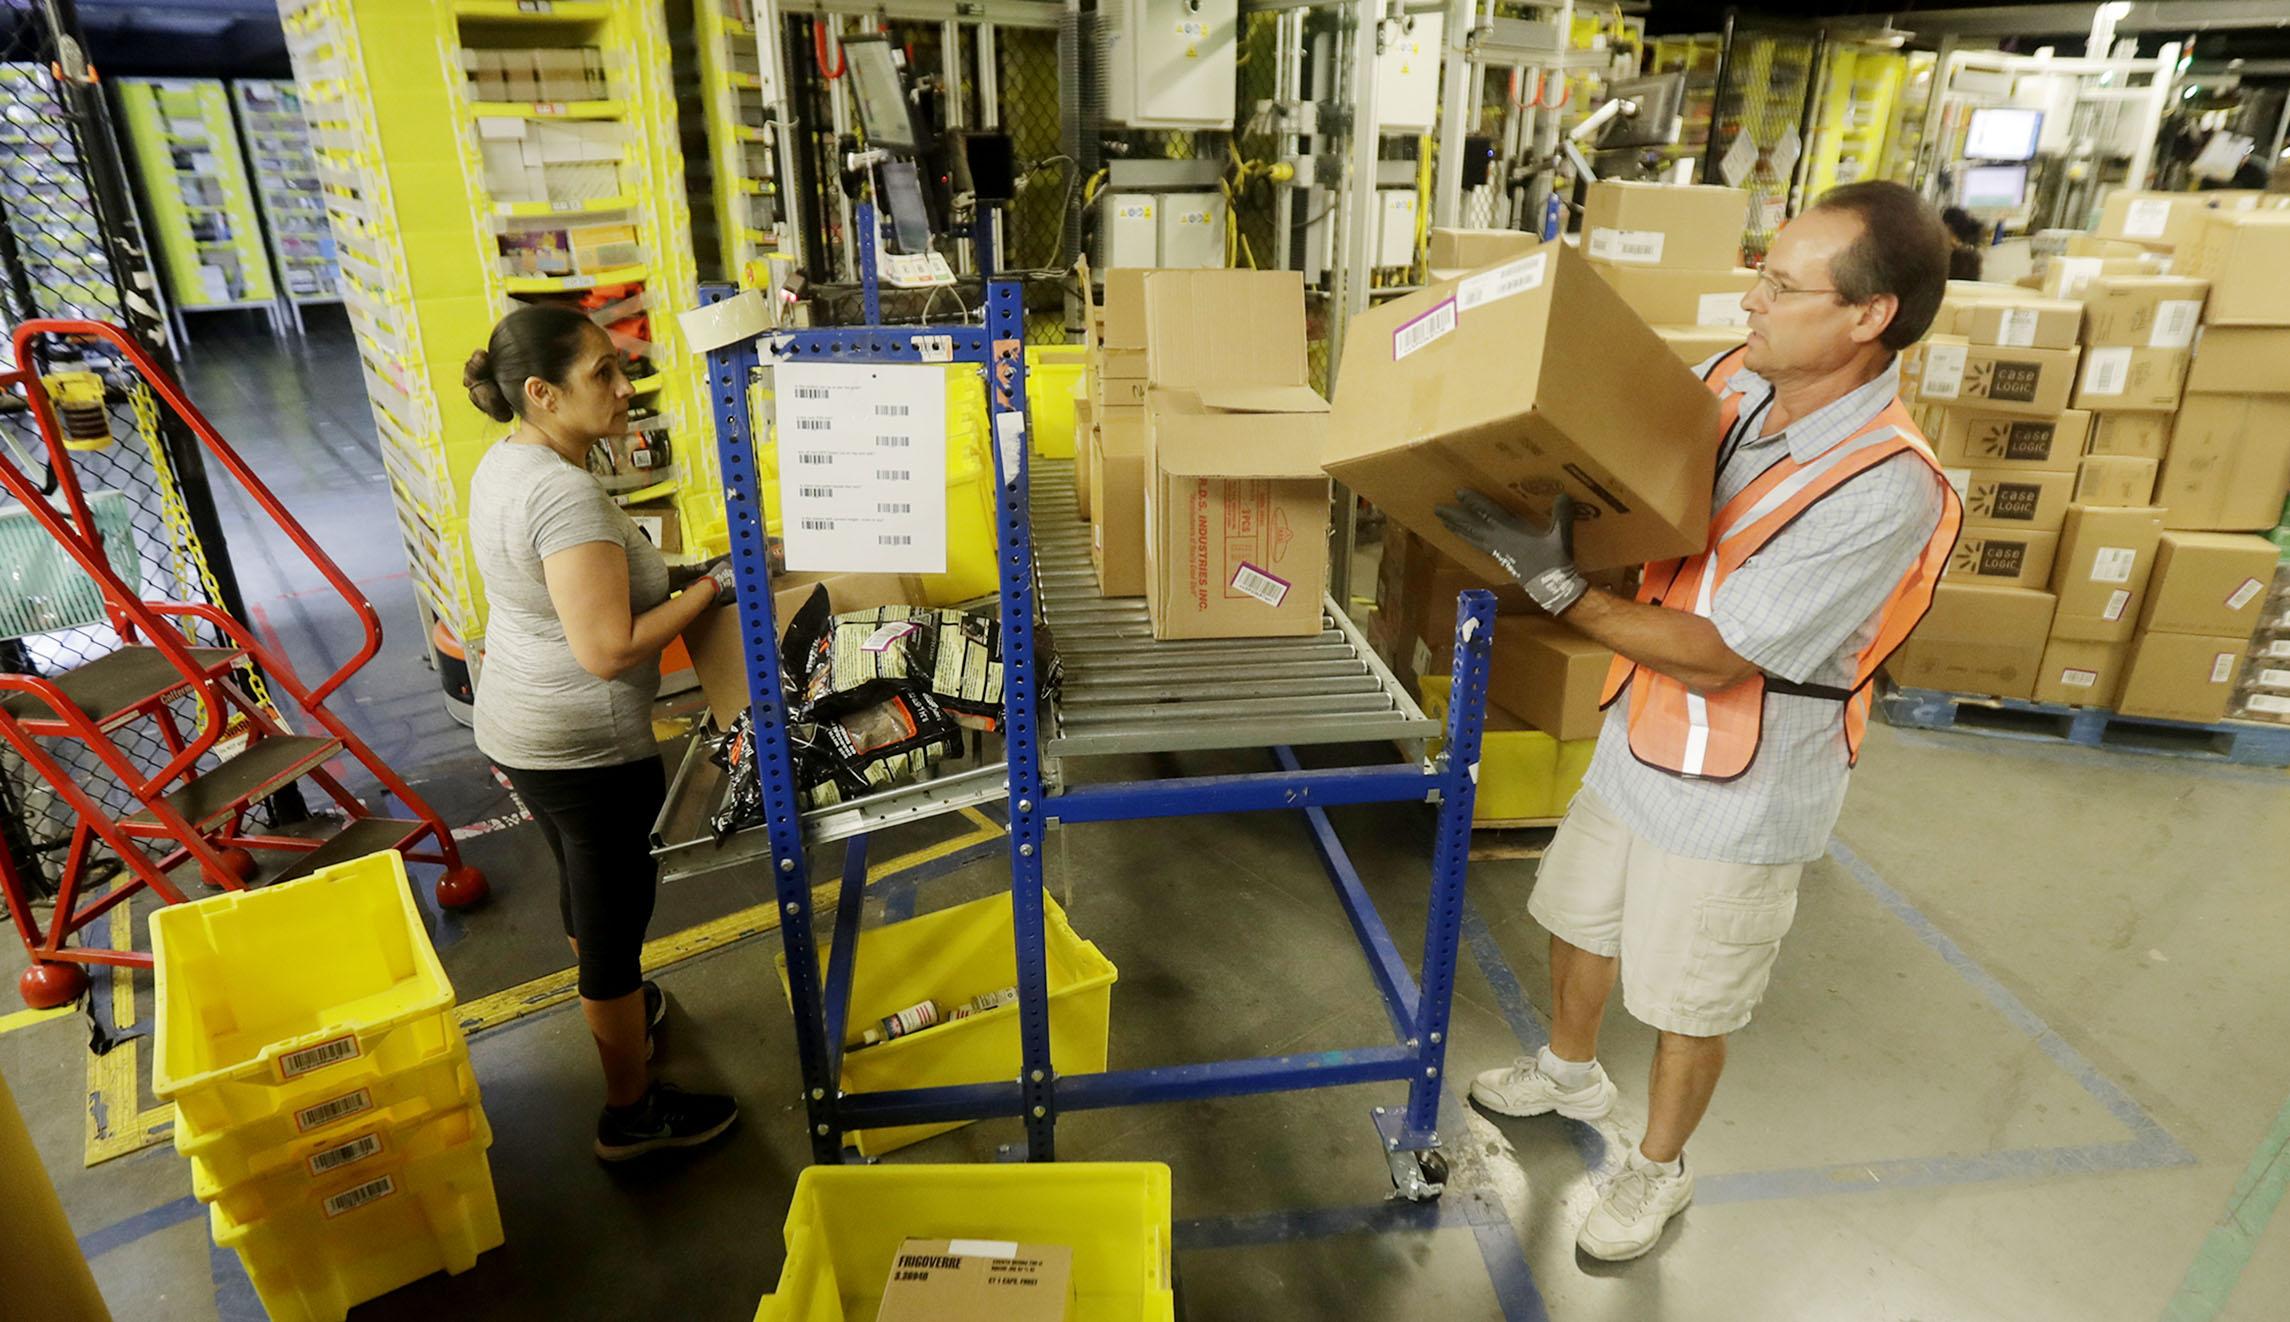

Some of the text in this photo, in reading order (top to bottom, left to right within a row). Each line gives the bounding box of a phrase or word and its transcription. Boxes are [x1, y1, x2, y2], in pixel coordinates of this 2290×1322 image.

[1999, 369, 2035, 381] case
[1996, 383, 2031, 393] LOGIC
[2015, 431, 2049, 441] case
[2012, 443, 2046, 451] LOGIC
[2001, 491, 2035, 501] case
[1999, 503, 2032, 512] LOGIC
[1198, 515, 1208, 586] INDUSTRIES
[1987, 549, 2021, 558] case
[1985, 560, 2017, 569] LOGIC
[1198, 589, 1208, 612] INC.
[898, 1255, 962, 1269] FRIGOVERRE
